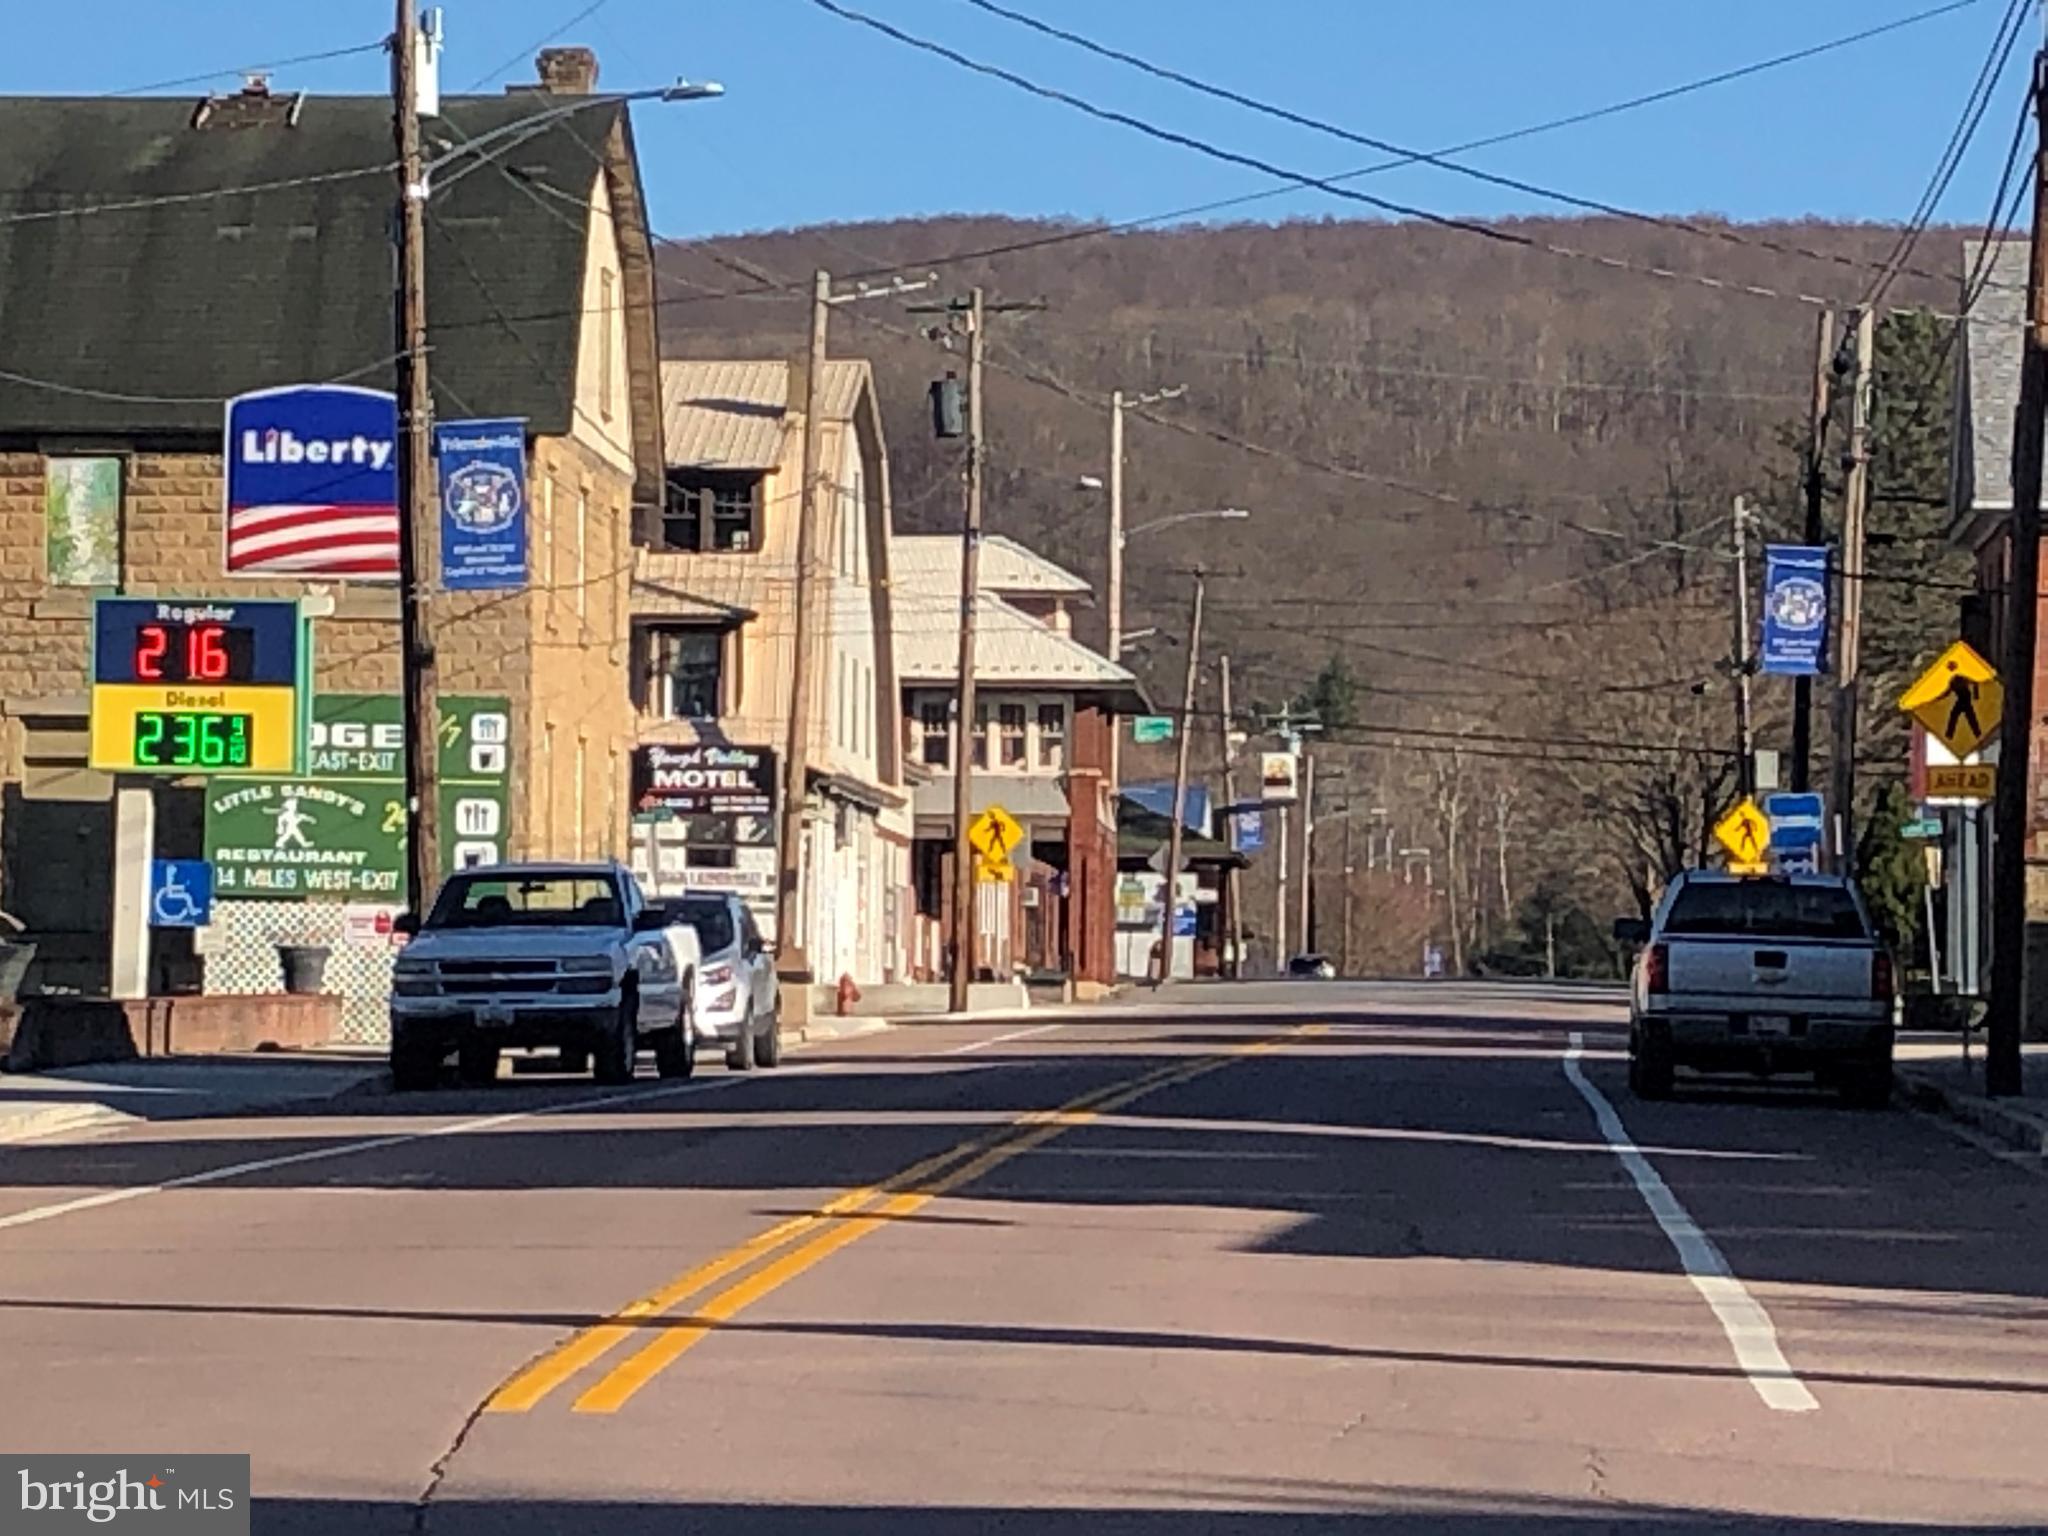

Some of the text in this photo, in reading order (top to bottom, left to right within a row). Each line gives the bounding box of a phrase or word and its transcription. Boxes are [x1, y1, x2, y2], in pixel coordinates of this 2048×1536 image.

[242, 427, 392, 471] Liberty
[157, 603, 235, 624] Regular
[166, 691, 225, 707] Diesel
[653, 769, 756, 789] MOTEL
[1935, 772, 1990, 788] AHEAD
[213, 785, 273, 814] LITTLE
[216, 848, 368, 865] RESTAURANT
[217, 867, 399, 890] 14 MILES WEST-EXIT
